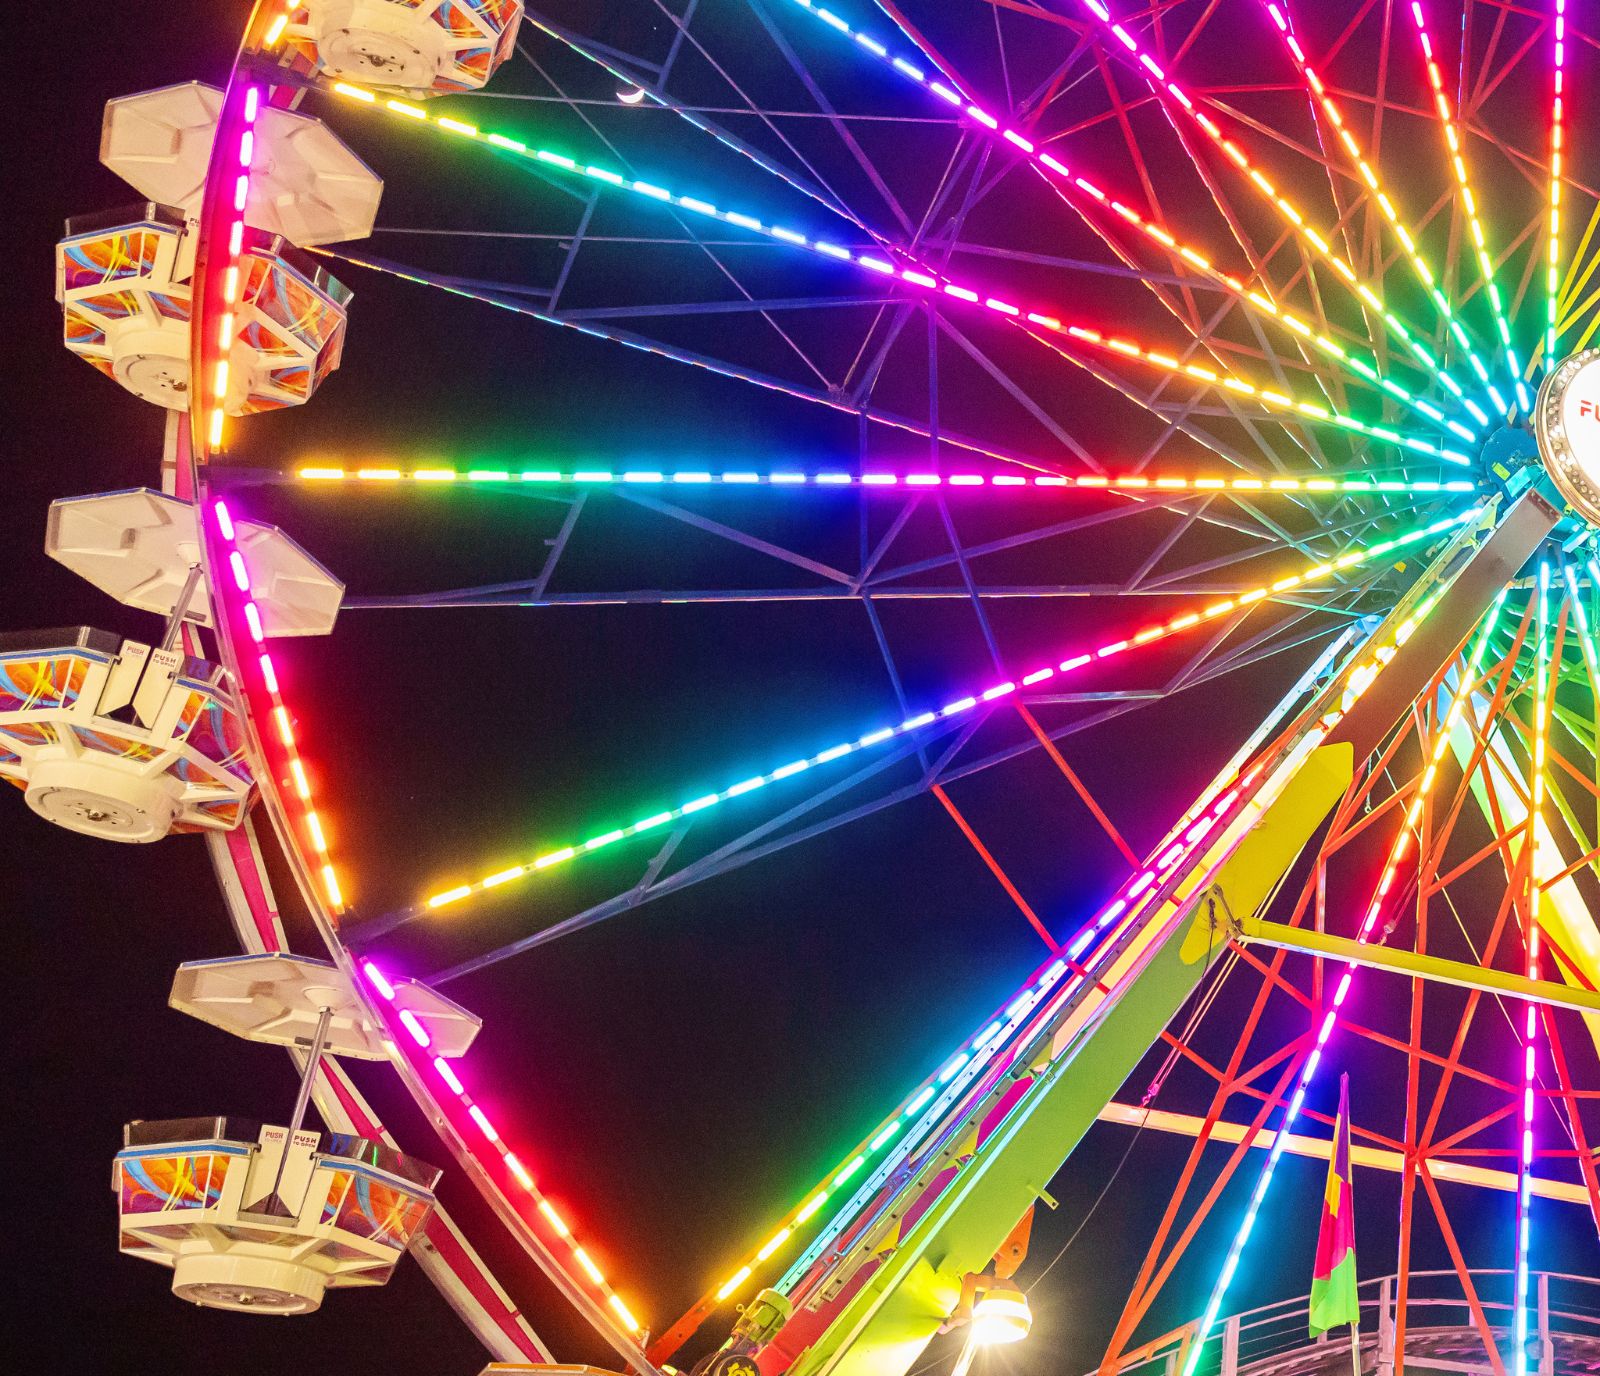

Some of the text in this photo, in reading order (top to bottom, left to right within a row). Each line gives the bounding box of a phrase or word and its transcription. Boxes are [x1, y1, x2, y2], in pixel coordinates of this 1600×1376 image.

[154, 653, 177, 664] PUSH
[265, 1131, 284, 1140] PUSH
[294, 1134, 318, 1144] PUSH
